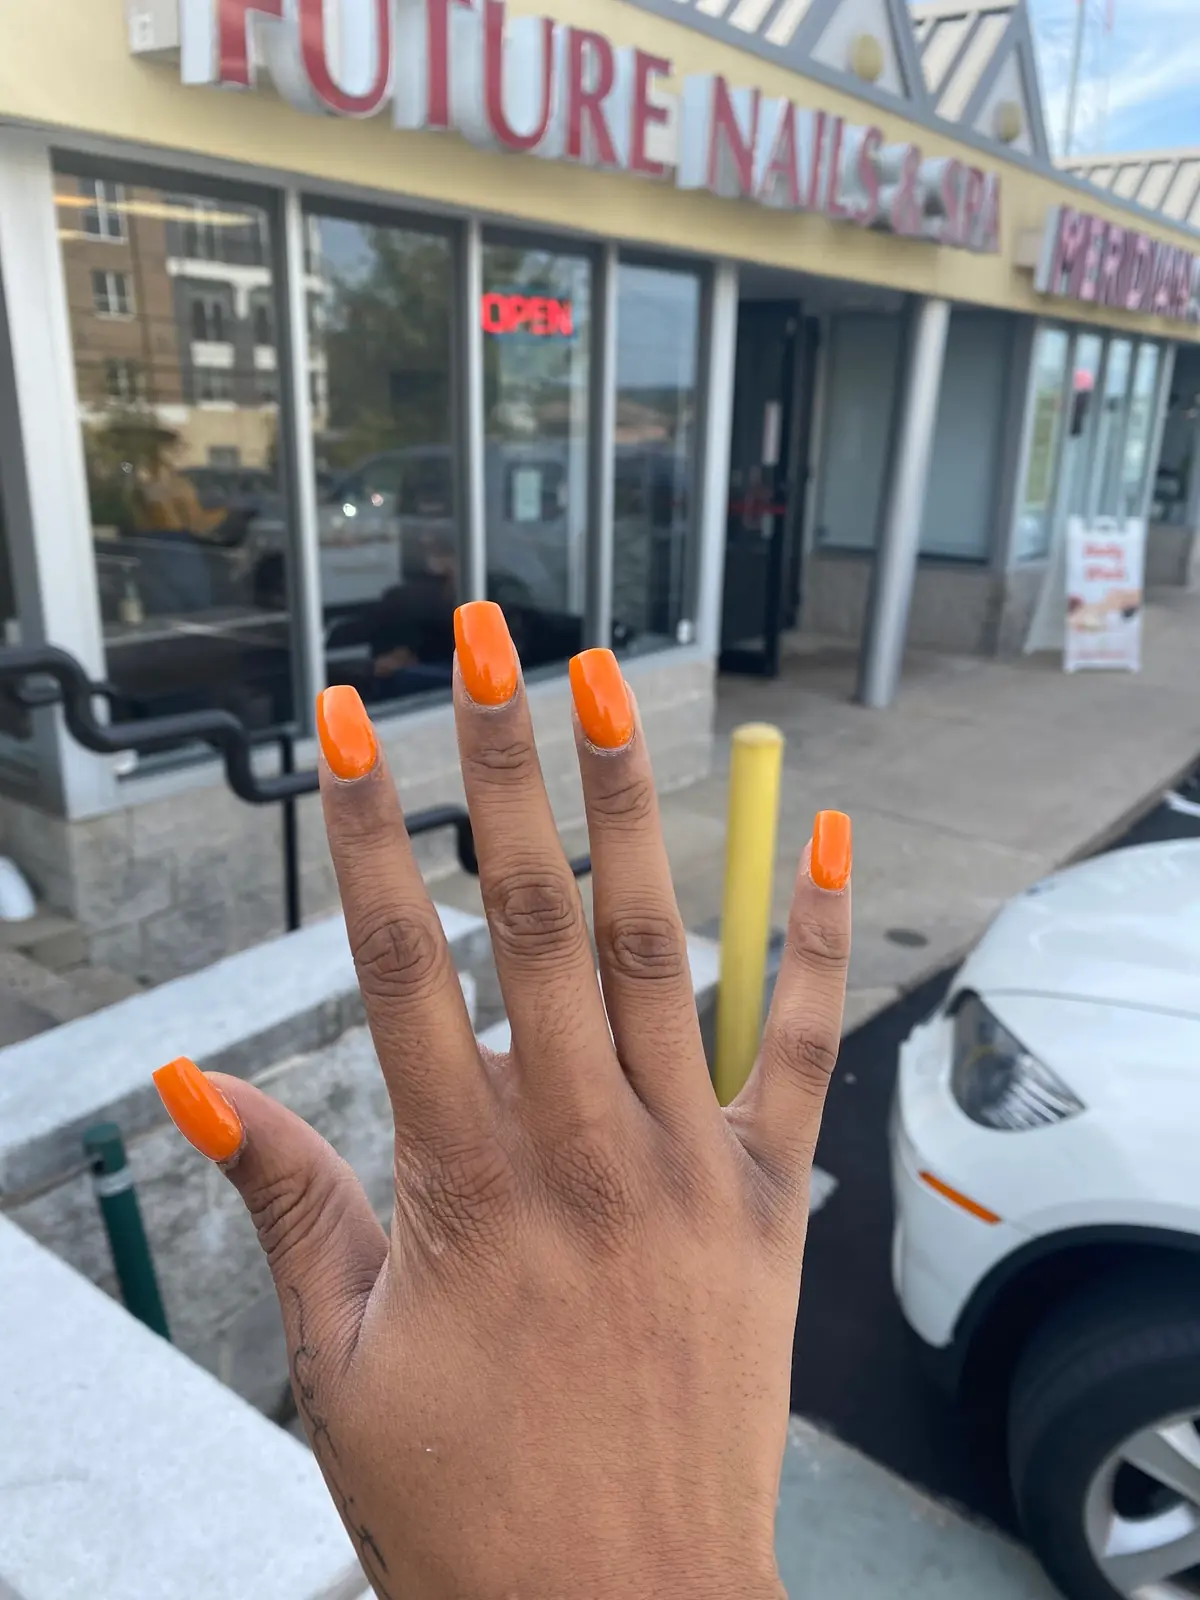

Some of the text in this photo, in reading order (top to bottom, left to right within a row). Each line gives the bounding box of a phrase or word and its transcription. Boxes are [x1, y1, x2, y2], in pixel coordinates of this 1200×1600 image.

[706, 72, 884, 224] NAILS
[890, 142, 925, 236] &
[934, 156, 1000, 254] SPA
[482, 292, 573, 337] OPEN
